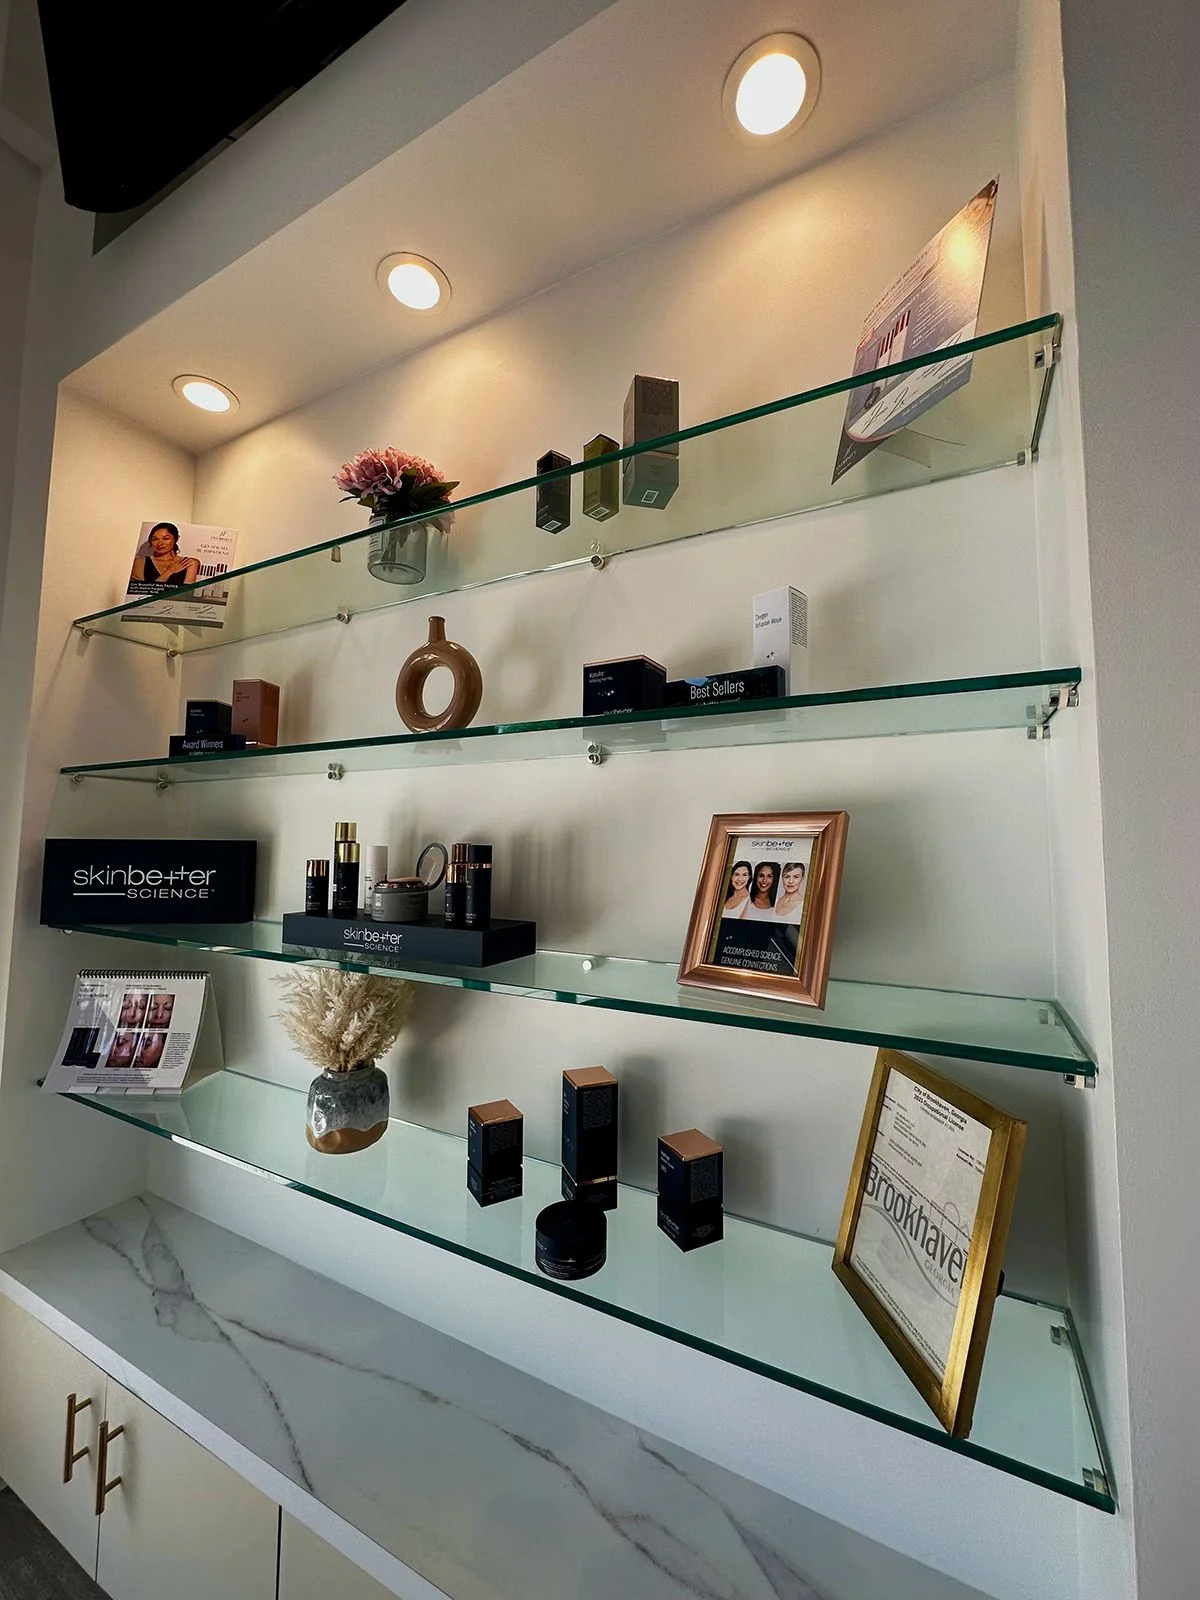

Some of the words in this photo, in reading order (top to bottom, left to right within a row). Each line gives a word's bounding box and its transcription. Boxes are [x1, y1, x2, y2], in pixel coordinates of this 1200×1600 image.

[690, 685, 711, 700] Best
[712, 680, 745, 697] Sellers
[182, 739, 200, 749] Award
[200, 738, 224, 749] Winners
[73, 864, 217, 886] skinbetter
[343, 926, 403, 945] skinbetter
[722, 945, 760, 958] ACCOMPLISHED
[923, 1258, 956, 1299] GEORGIA
